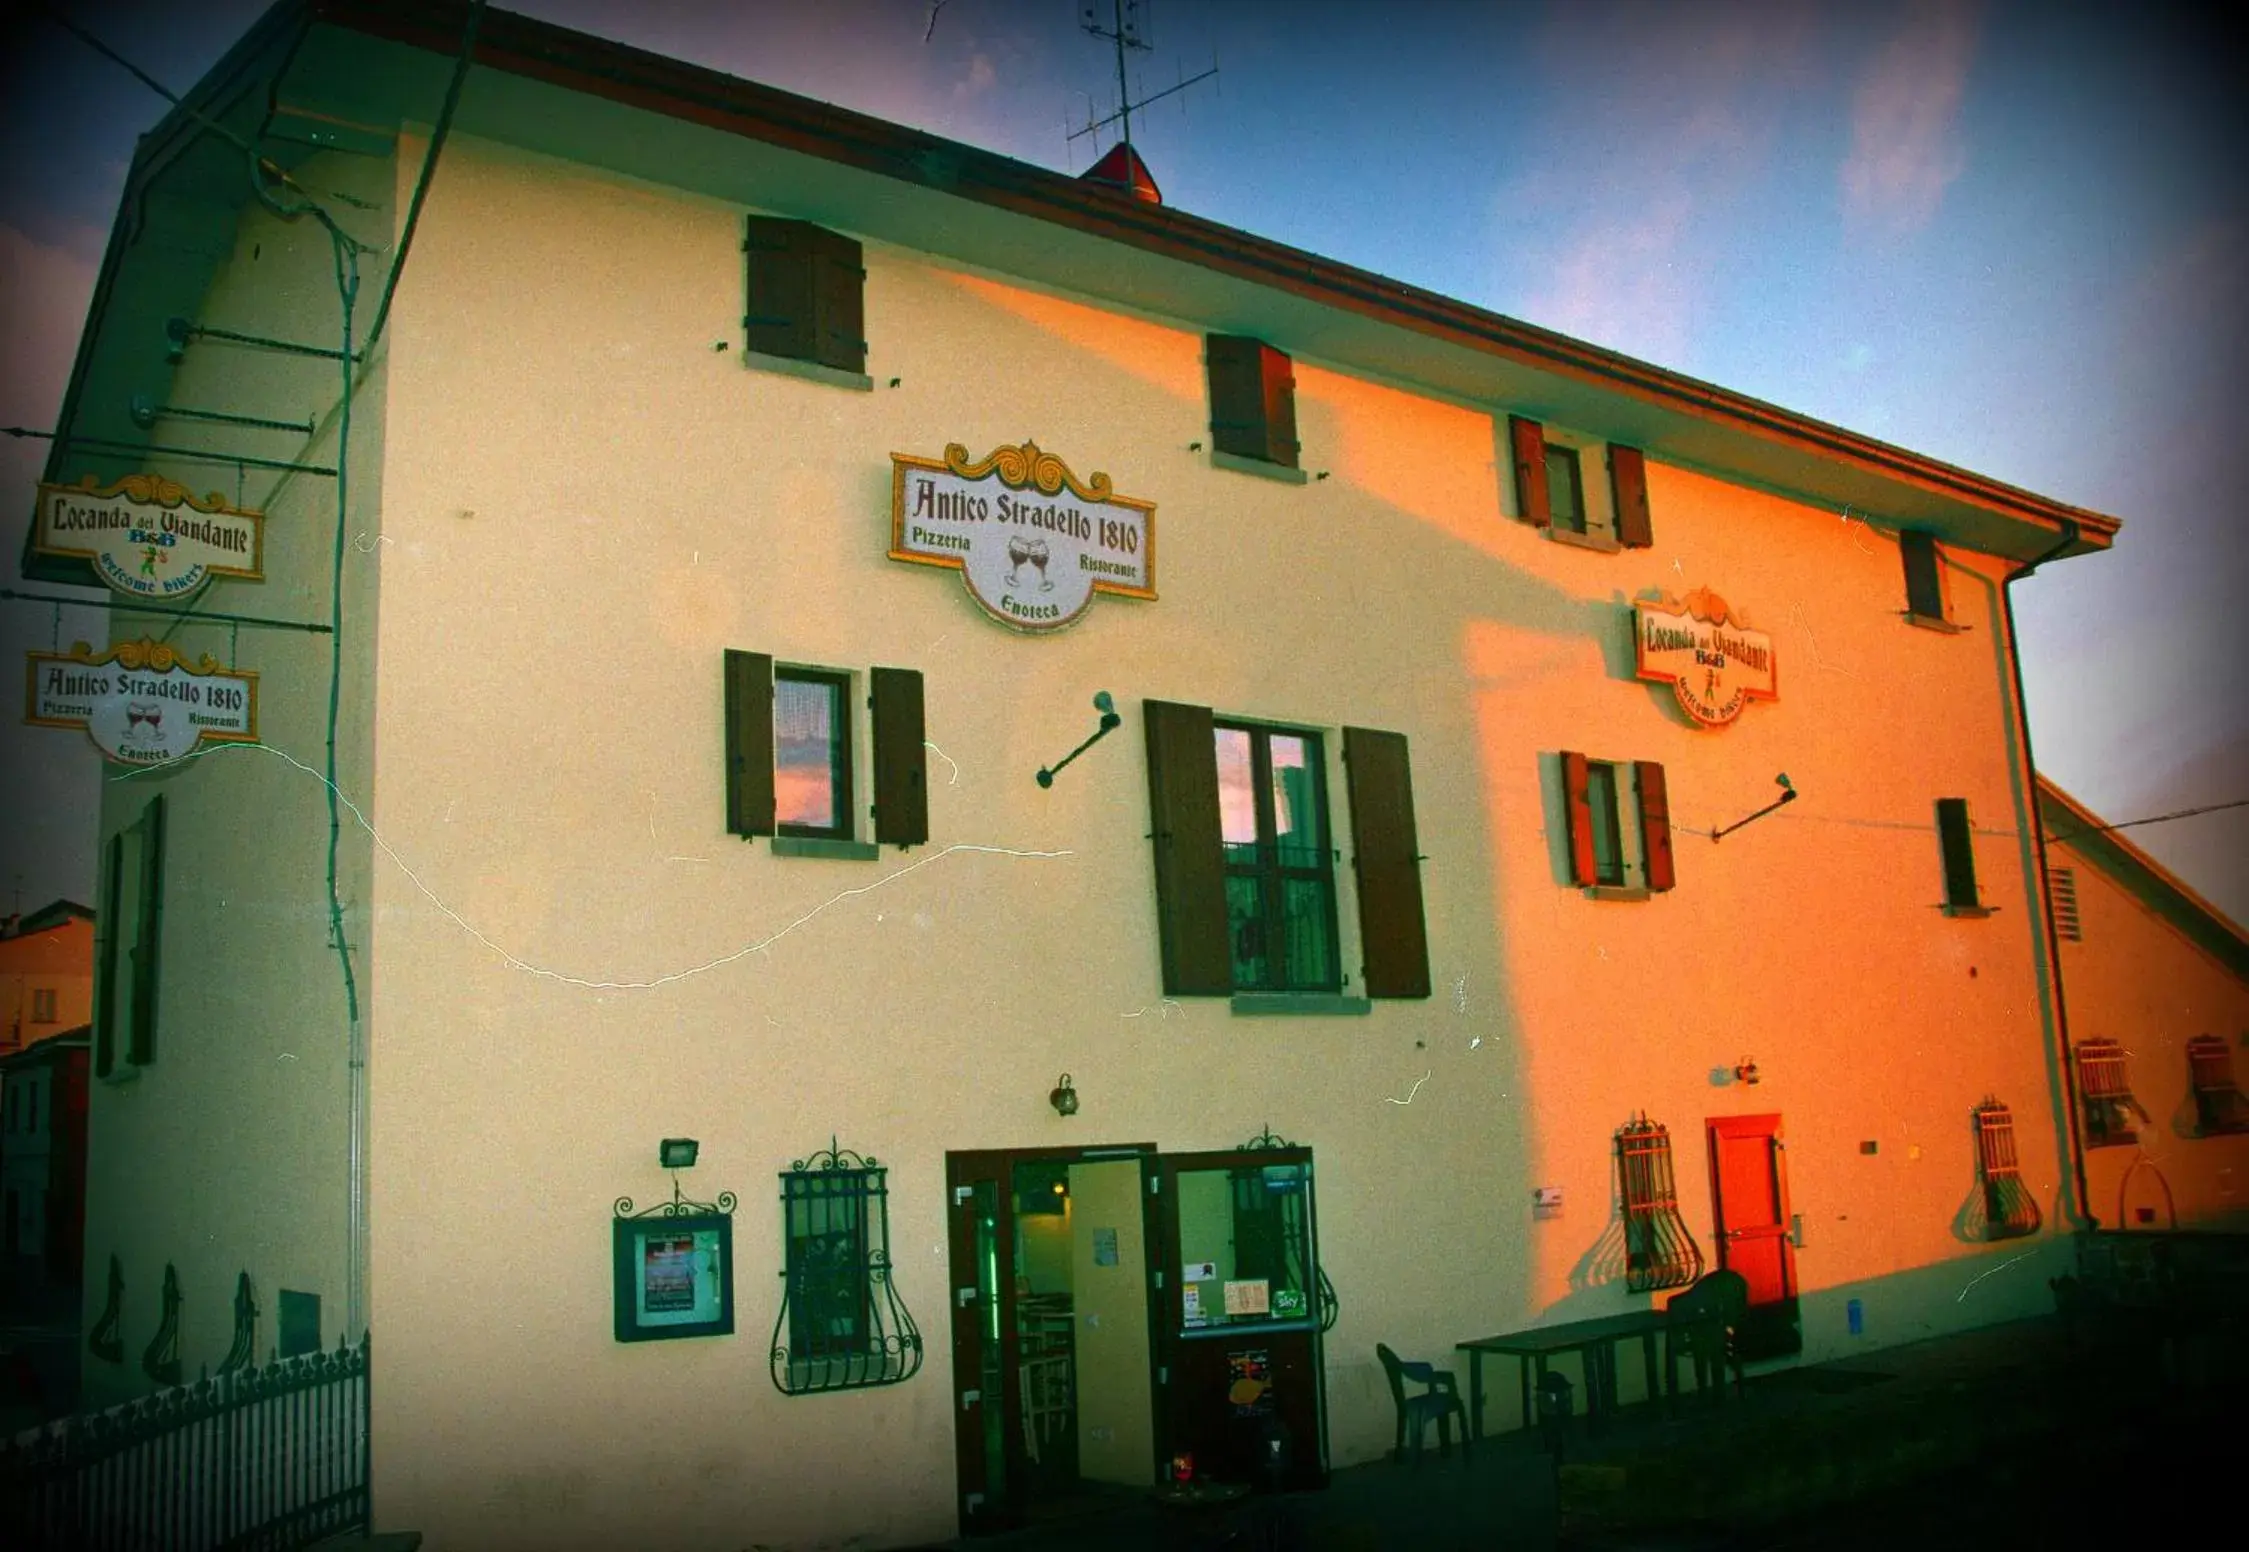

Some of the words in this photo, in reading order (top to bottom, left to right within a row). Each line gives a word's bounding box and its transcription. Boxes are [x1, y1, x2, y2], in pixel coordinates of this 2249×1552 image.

[54, 499, 130, 531] Locanda
[160, 511, 249, 553] Viandante
[912, 478, 988, 522] Antico
[997, 494, 1091, 541] Stradello
[1099, 517, 1138, 555] 1810
[912, 527, 971, 551] Pizzeria
[1080, 554, 1138, 578] Ristorante
[1001, 595, 1060, 618] Enoteca
[1646, 617, 1696, 652] Locanda
[46, 668, 110, 696] Antico
[117, 674, 200, 704] Stradello
[206, 686, 242, 711] 1810
[43, 701, 93, 716] Pizzeria
[188, 711, 240, 728] Ristorante
[117, 744, 170, 760] Enoteca
